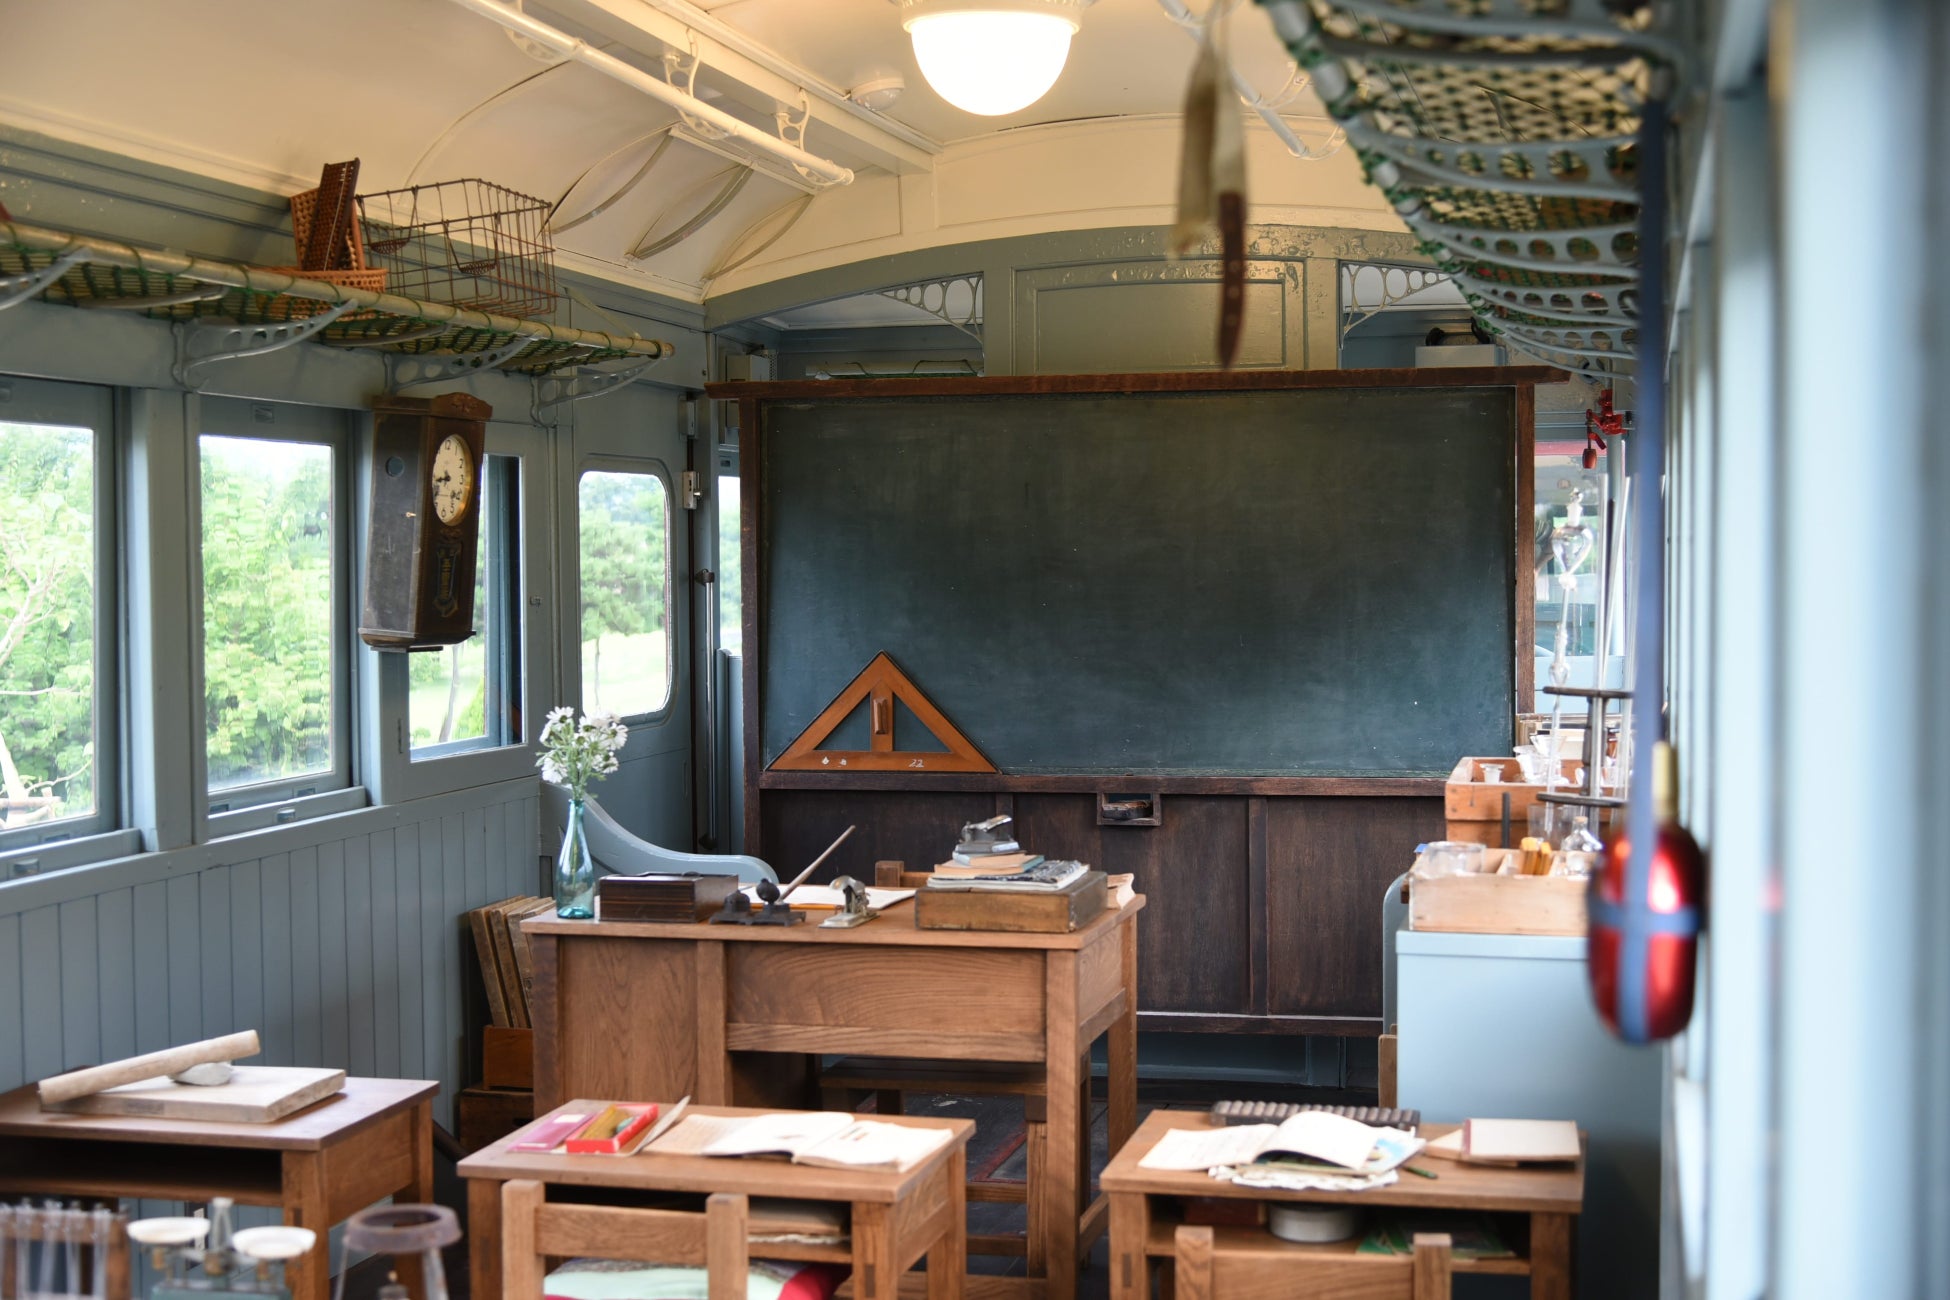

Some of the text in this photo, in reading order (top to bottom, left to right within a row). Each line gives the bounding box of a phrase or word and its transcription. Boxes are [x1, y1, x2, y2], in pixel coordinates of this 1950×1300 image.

[444, 439, 451, 450] 12
[459, 458, 464, 469] 2
[459, 474, 464, 485] 3
[441, 506, 447, 518] 6
[450, 502, 455, 514] 5
